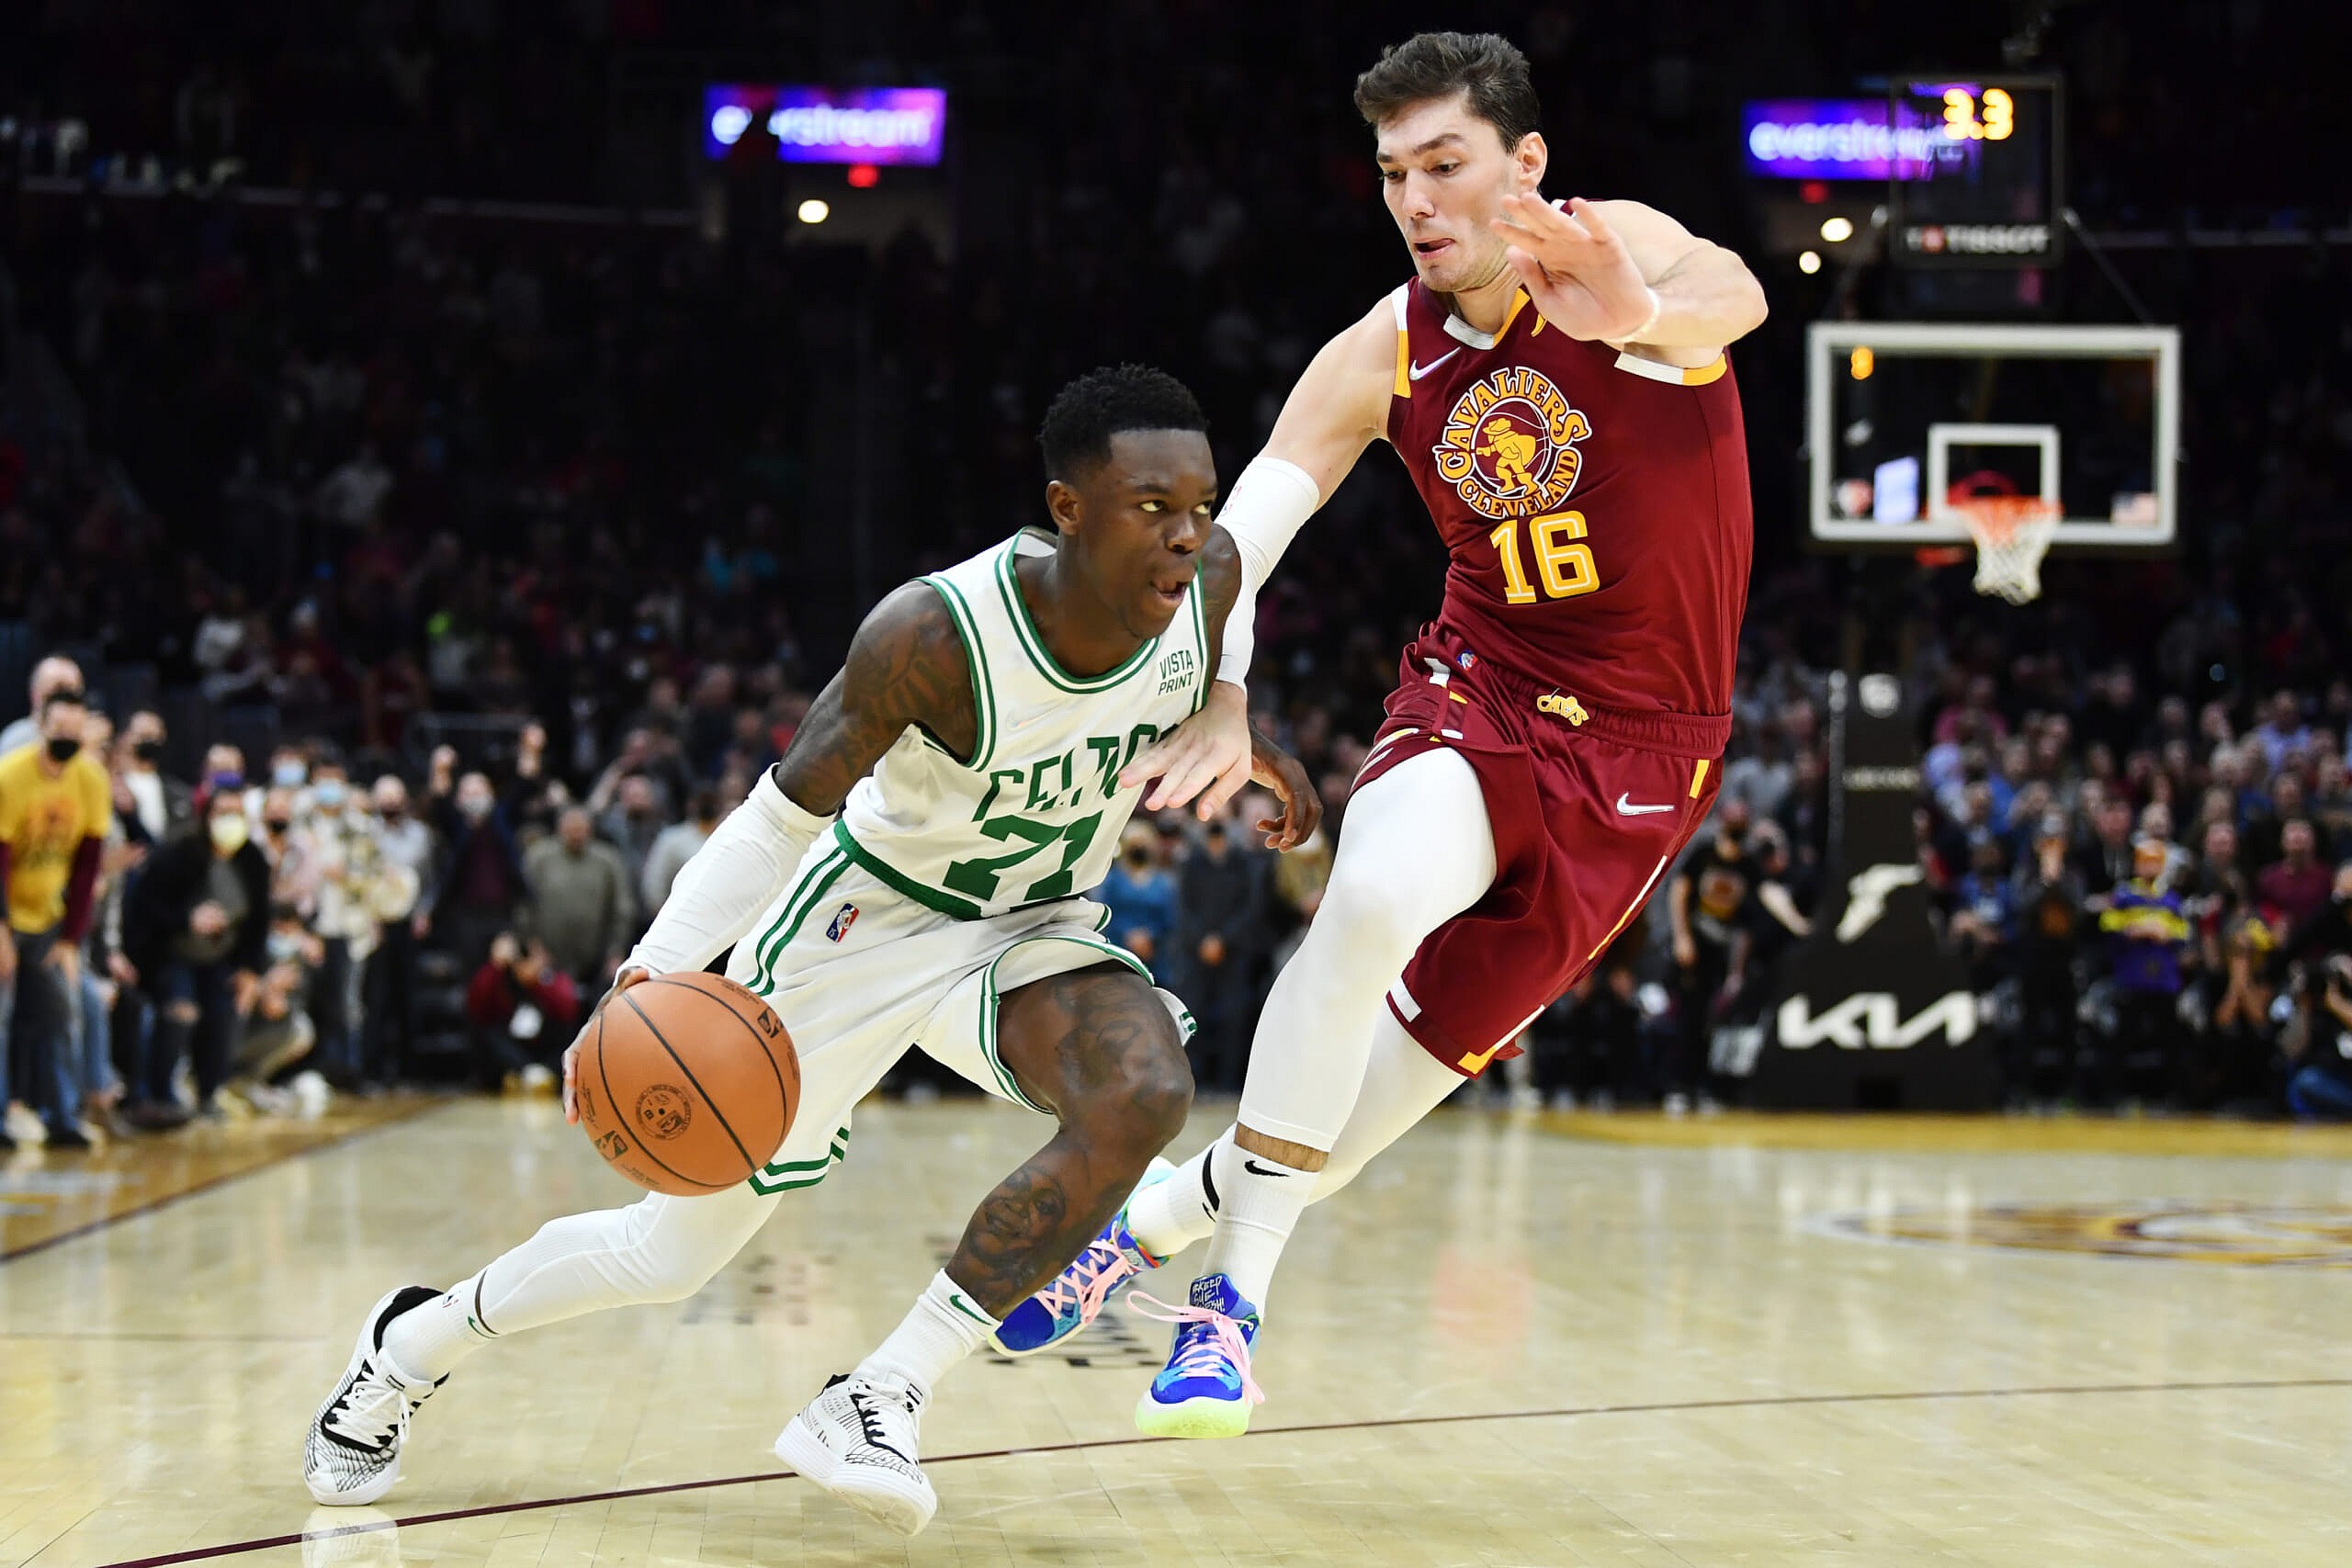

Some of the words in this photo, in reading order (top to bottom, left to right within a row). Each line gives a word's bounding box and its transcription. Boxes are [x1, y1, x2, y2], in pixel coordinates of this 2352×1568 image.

[711, 105, 932, 146] erstream
[1943, 88, 2013, 140] 3.3
[1434, 367, 1591, 482] CAVALIERS
[1457, 447, 1581, 518] CLEVELAND
[1489, 510, 1600, 604] 16
[1158, 671, 1193, 696] PRINT
[1159, 649, 1193, 680] VISTA
[1536, 694, 1589, 727] CAVS
